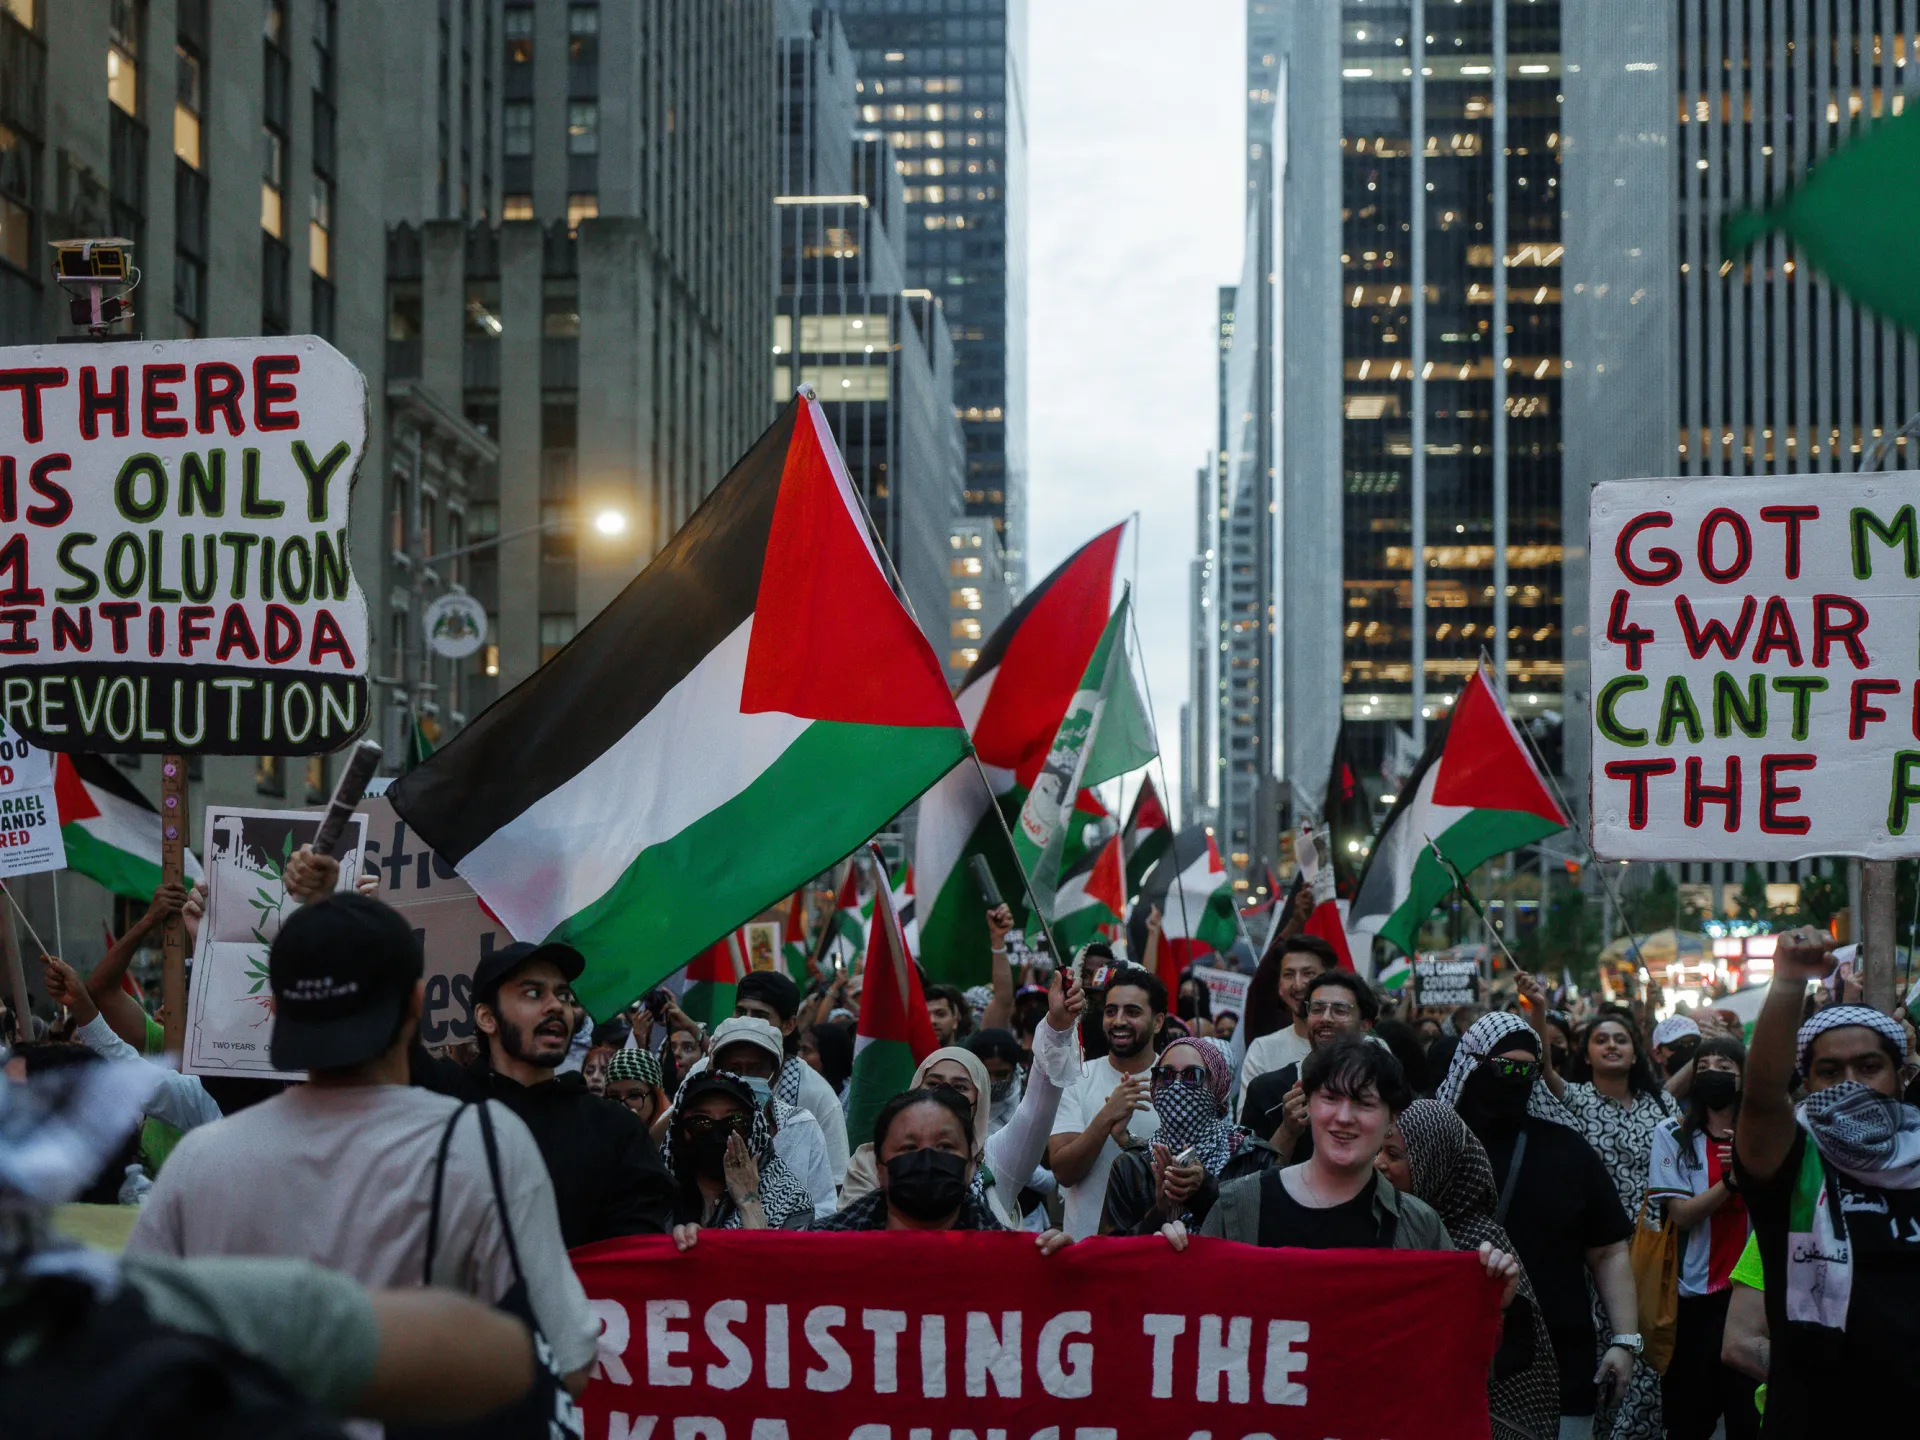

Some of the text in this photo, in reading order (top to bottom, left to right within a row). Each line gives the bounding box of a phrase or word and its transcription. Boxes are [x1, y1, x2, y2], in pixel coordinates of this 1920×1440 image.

[0, 355, 300, 443] THERE
[0, 440, 351, 527] IS ONLY
[0, 528, 351, 607] 1 SOLUTION
[1615, 503, 1920, 587] GOT M
[0, 602, 356, 669] INTIFADA
[1607, 589, 1870, 671] 4 WAR
[3, 676, 359, 746] REVOLUTION
[1596, 671, 1829, 747] CANT
[1605, 754, 1817, 836] THE
[1420, 989, 1474, 1005] GENOCIDE
[212, 1041, 230, 1050] TWO
[231, 1042, 256, 1052] YEARS
[1792, 1241, 1849, 1265] فلسطين
[587, 1297, 1093, 1399] RESISTING
[1143, 1313, 1309, 1407] THE
